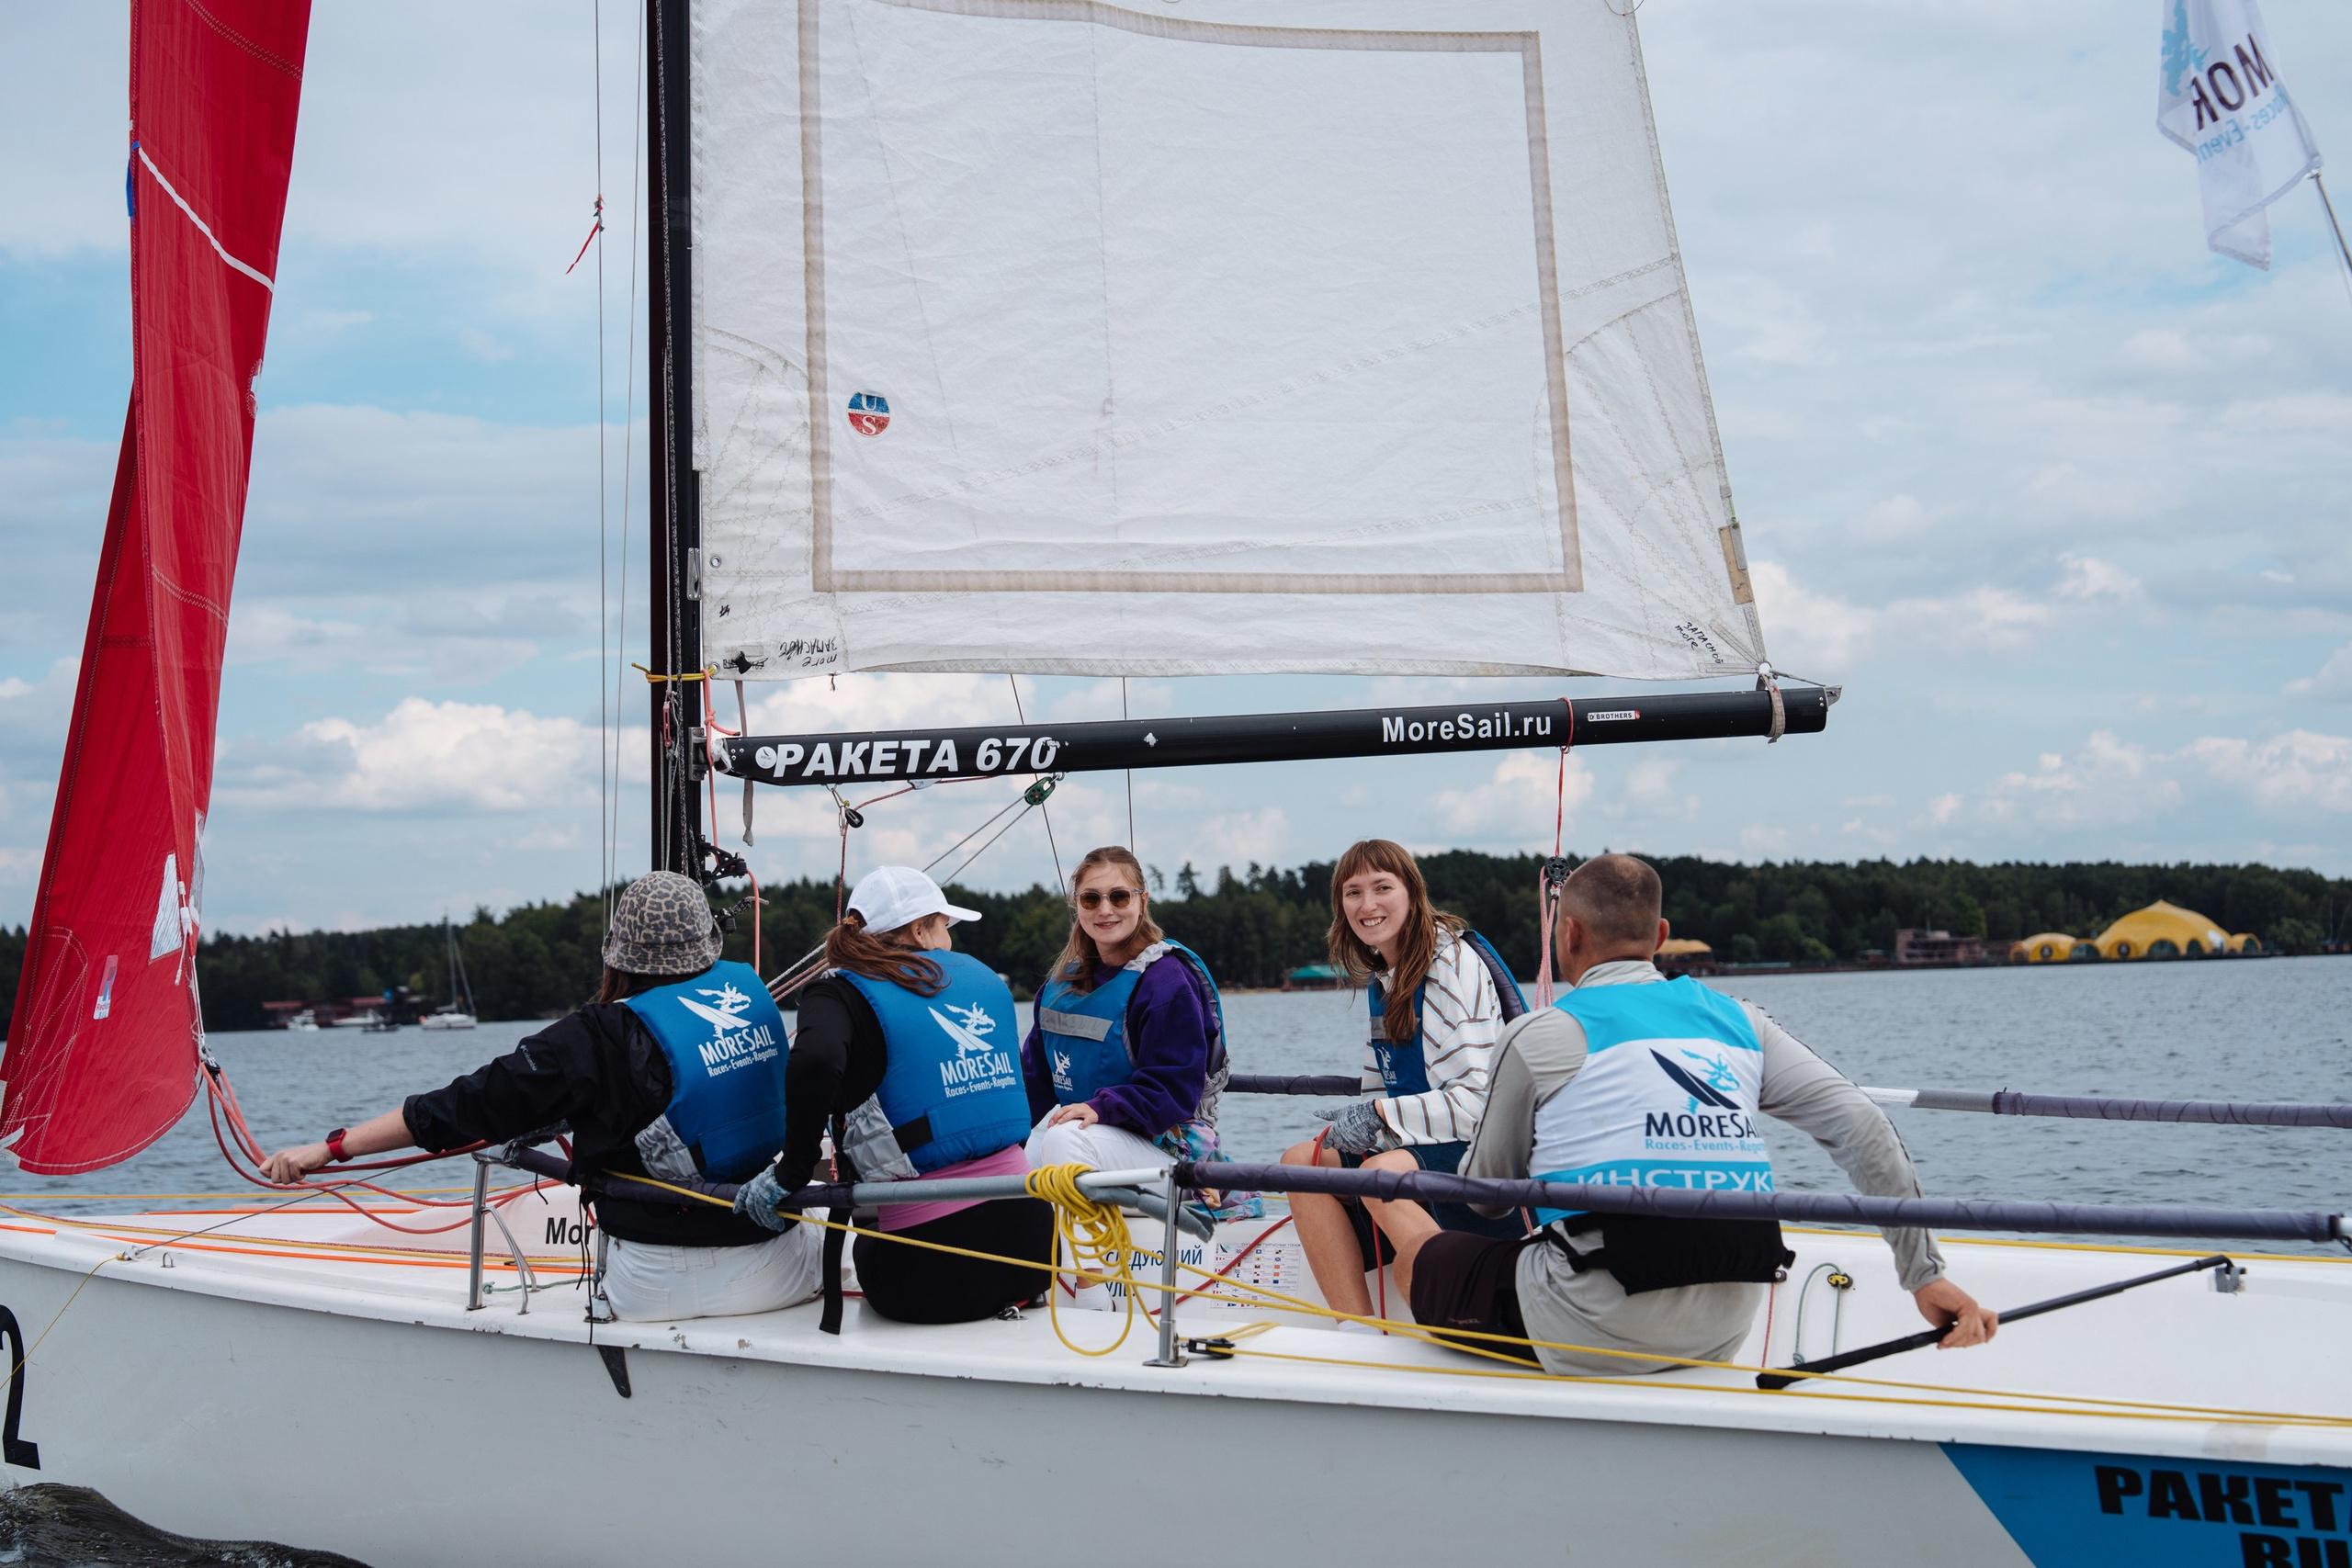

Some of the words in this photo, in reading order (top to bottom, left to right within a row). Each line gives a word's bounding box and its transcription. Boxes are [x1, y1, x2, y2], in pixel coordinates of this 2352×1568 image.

[1382, 712, 1551, 742] MoreSail.ru
[976, 738, 1057, 772] 670
[1577, 1168, 1772, 1192] ИНСТРУК
[2094, 1465, 2352, 1532] РАКЕТ
